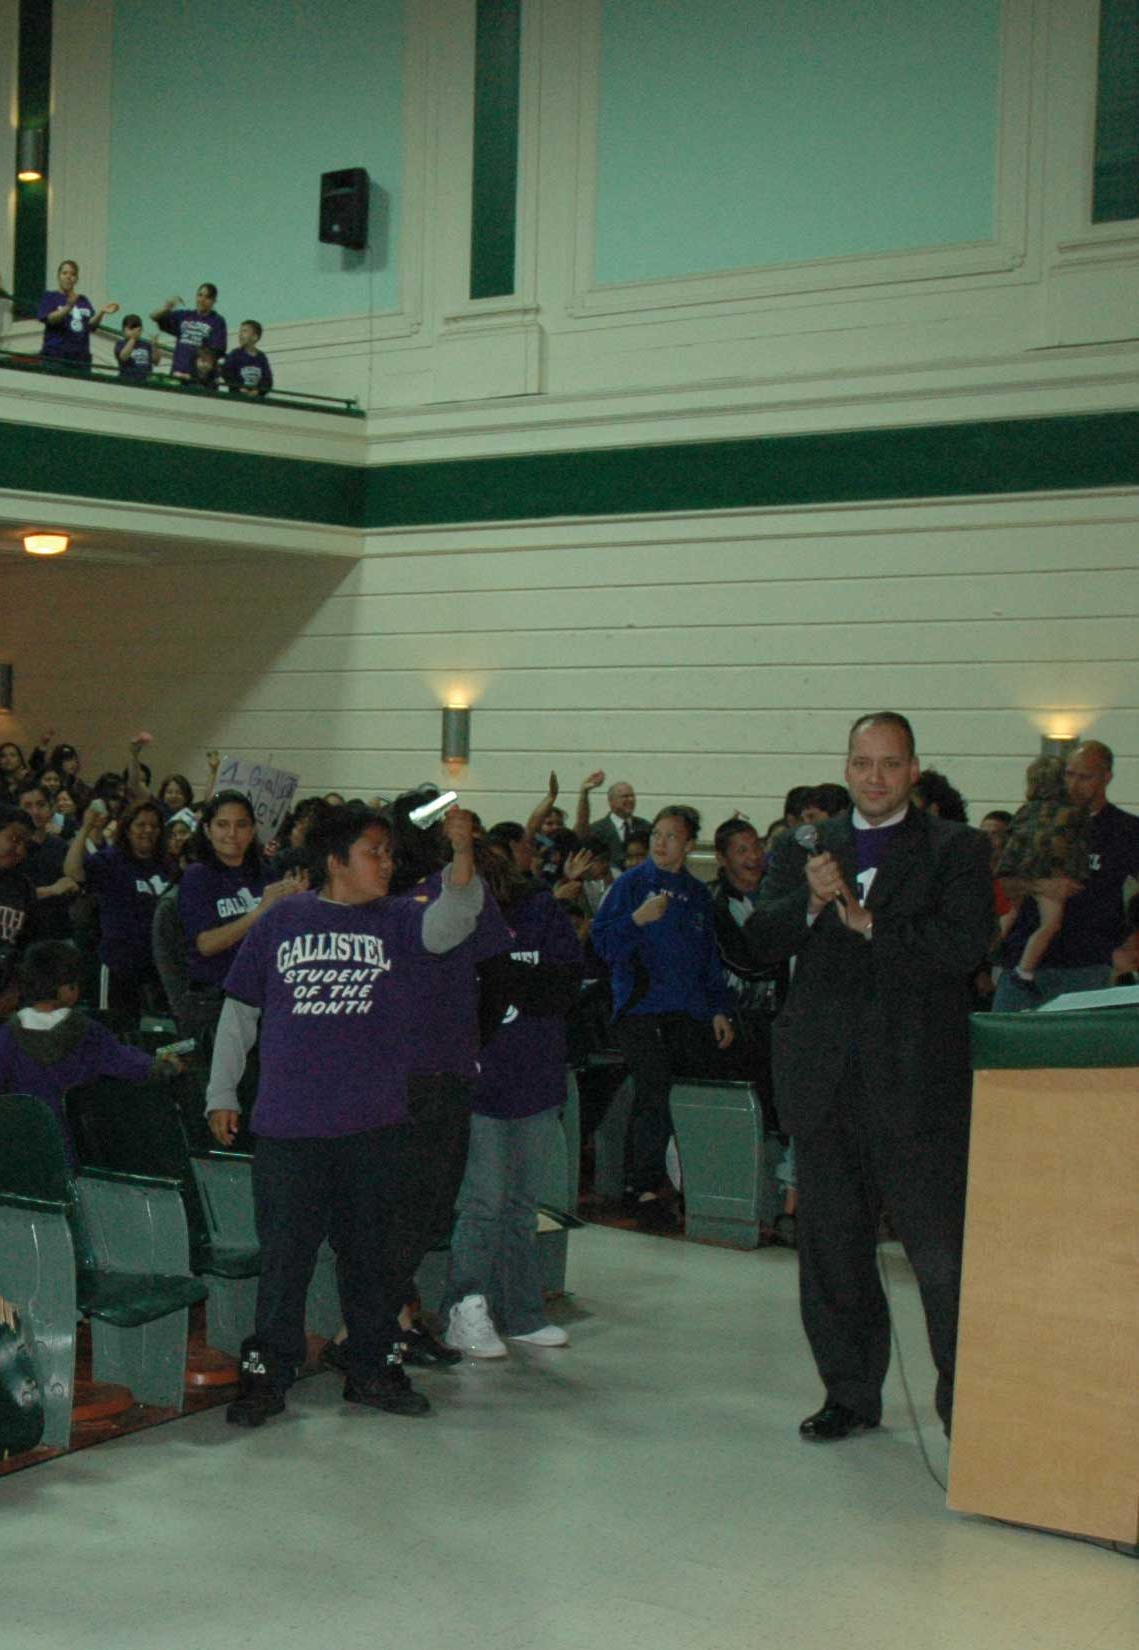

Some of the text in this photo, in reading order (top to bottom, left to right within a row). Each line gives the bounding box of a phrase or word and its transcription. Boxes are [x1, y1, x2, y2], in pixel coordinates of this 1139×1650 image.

[277, 932, 391, 973] GALLISTEL
[284, 968, 383, 984] STUDENT
[293, 984, 373, 999] OF THE
[292, 1000, 373, 1015] MONTH
